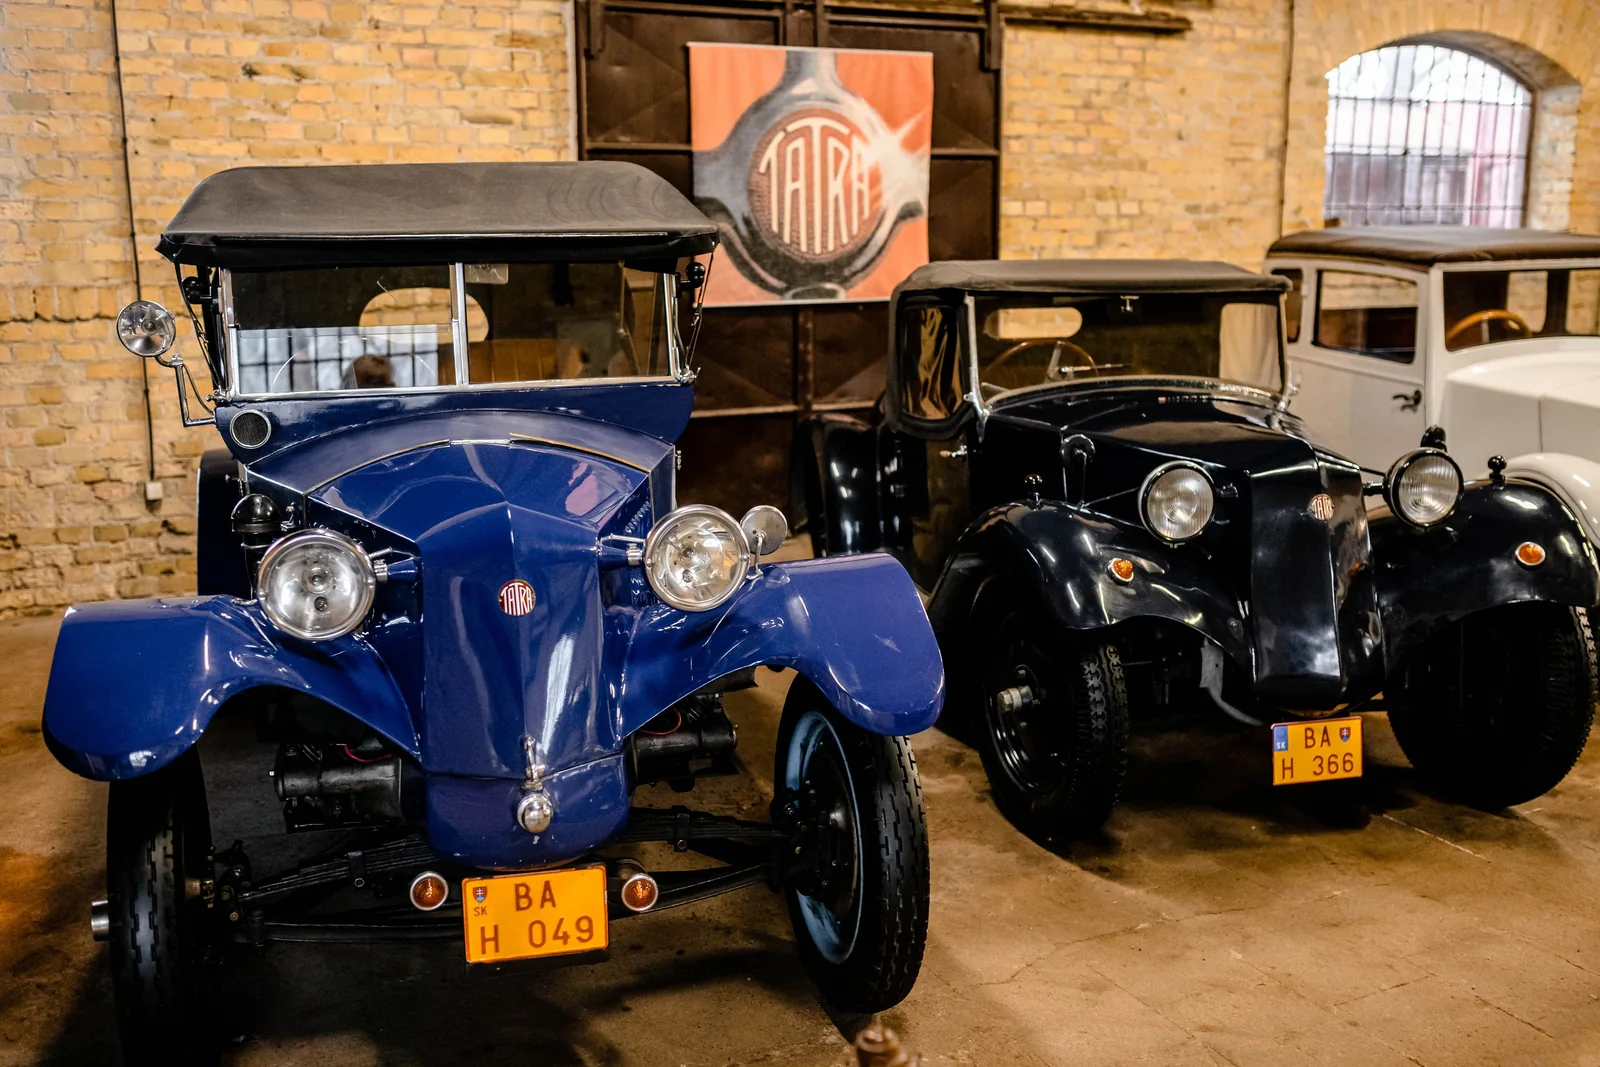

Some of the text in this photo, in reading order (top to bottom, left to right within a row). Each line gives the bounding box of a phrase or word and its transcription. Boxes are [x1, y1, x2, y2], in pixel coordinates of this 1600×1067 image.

[759, 116, 870, 255] TATRA
[500, 582, 533, 616] TATRA
[1276, 741, 1286, 750] SK
[1304, 725, 1331, 749] BA
[1282, 752, 1354, 780] H 366
[514, 880, 556, 912] BA
[473, 906, 488, 917] SK
[480, 915, 594, 955] H 049
